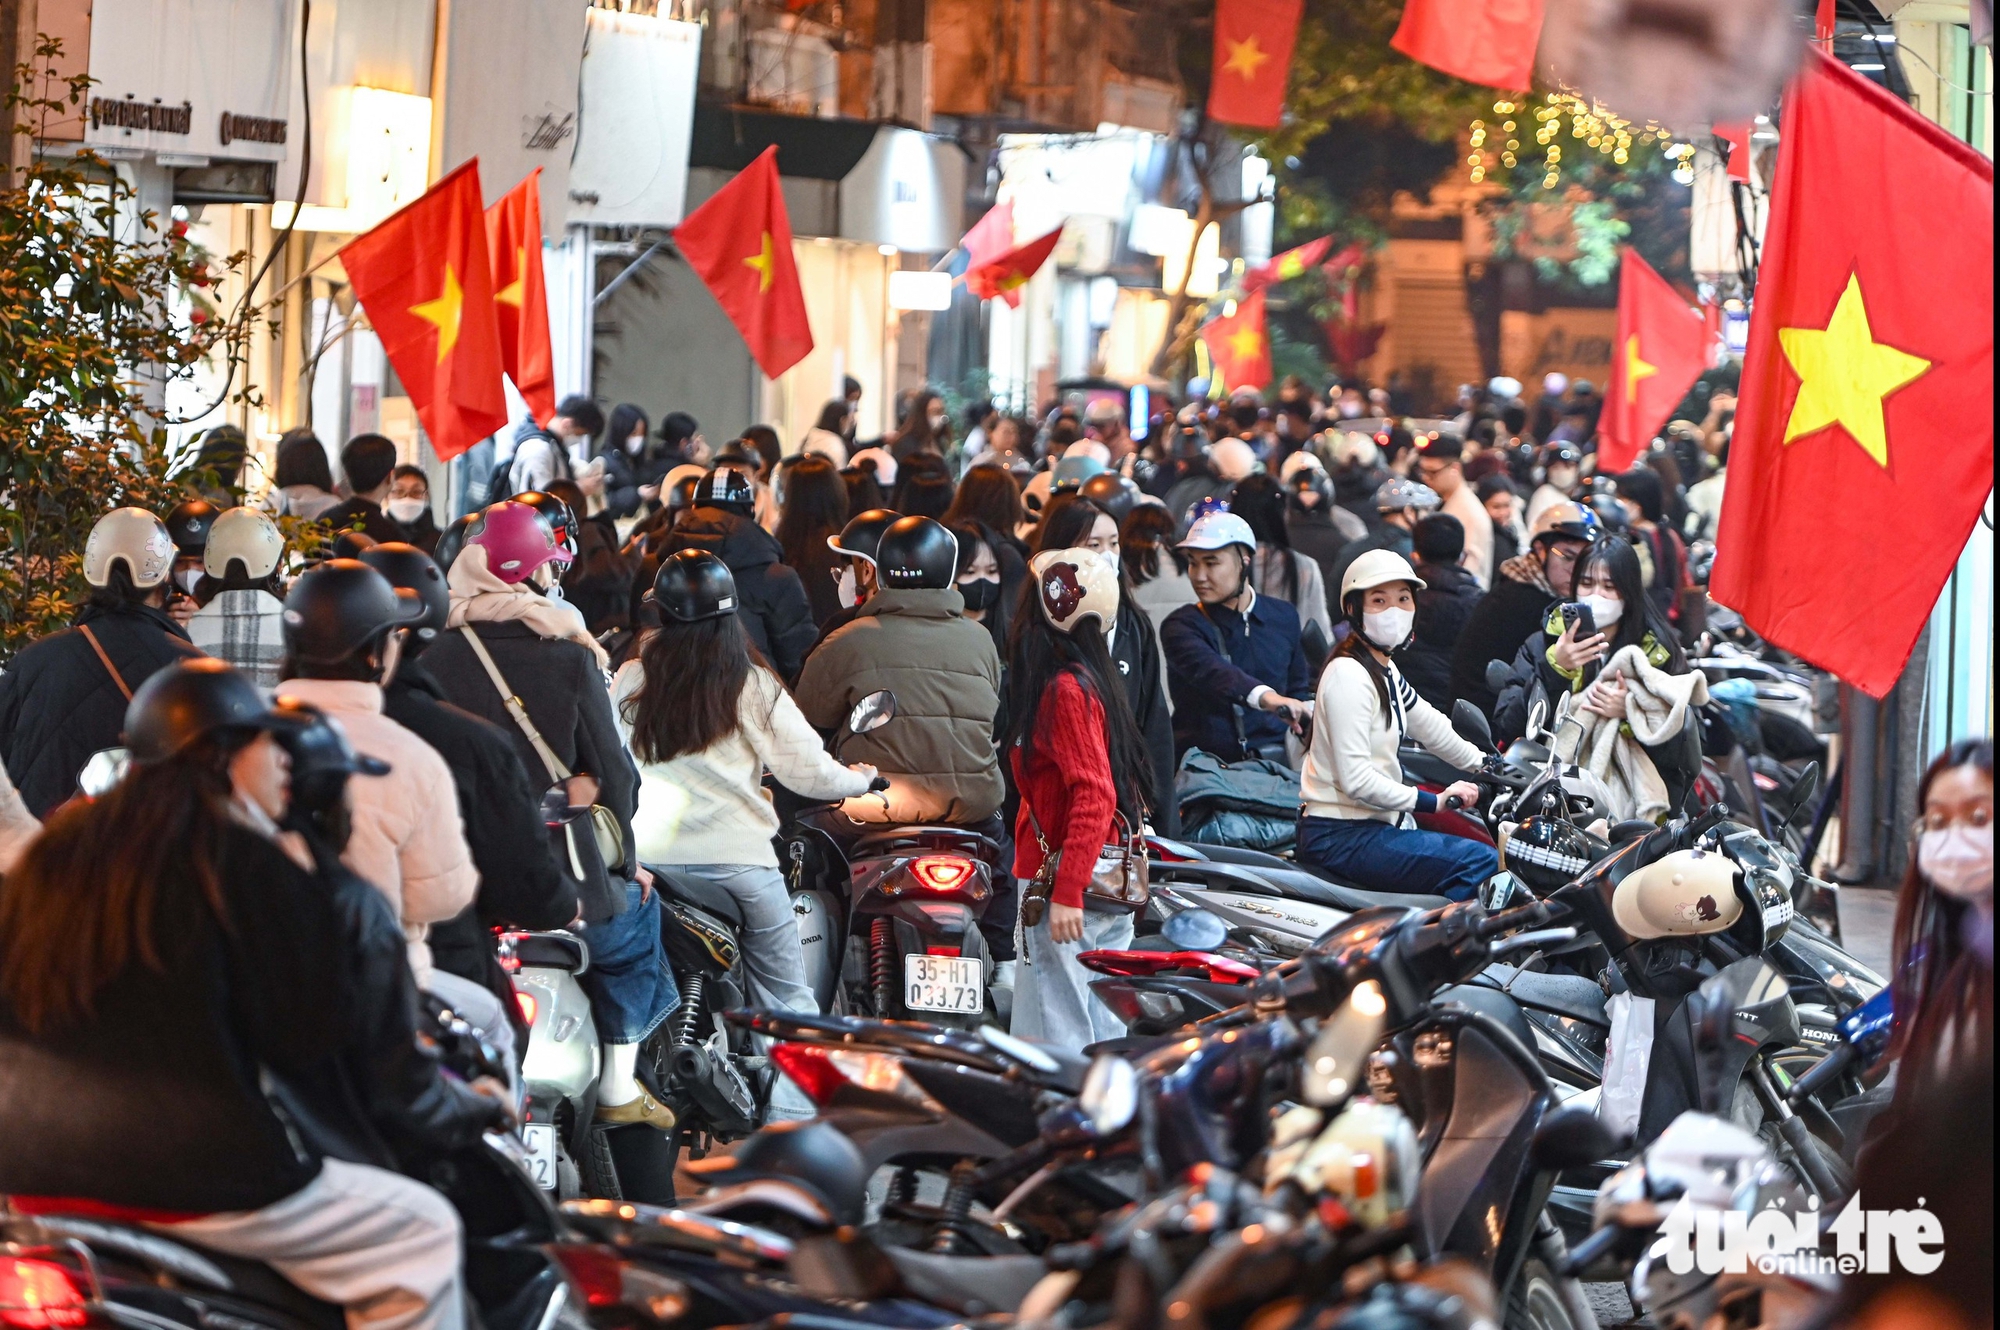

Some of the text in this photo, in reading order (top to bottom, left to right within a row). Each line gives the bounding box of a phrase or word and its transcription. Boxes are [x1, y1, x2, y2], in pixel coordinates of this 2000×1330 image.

[801, 934, 823, 945] ONDA
[917, 959, 968, 984] 35-H1
[911, 983, 977, 1010] 033.73
[1801, 1027, 1842, 1042] HON
